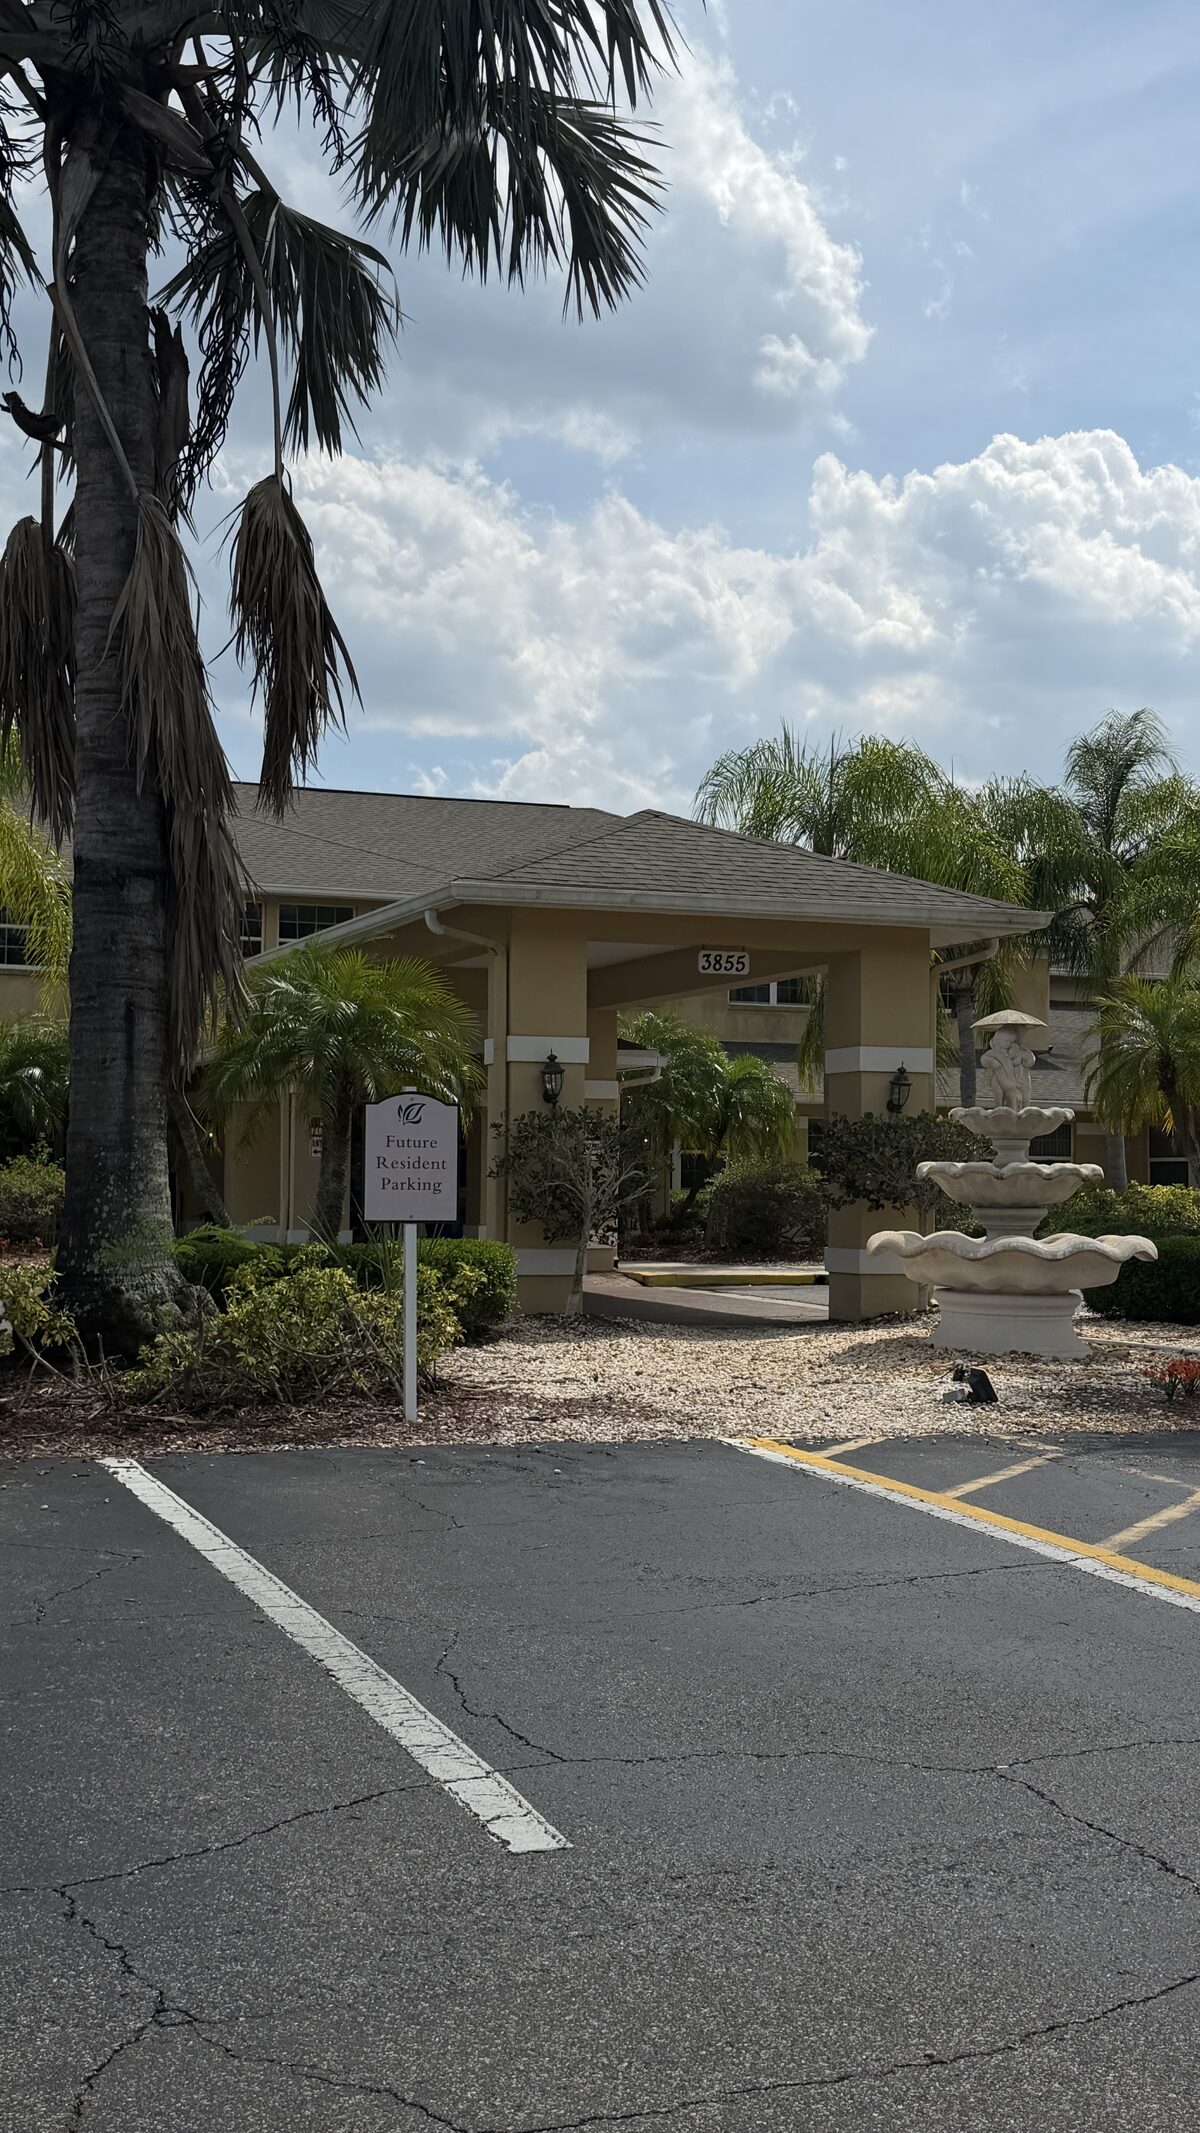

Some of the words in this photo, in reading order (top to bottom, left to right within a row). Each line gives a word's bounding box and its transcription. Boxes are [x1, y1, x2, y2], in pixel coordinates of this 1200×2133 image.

[701, 953, 746, 972] 3855
[385, 1135, 438, 1149] Future
[376, 1156, 447, 1170] Resident
[381, 1177, 442, 1195] Parking
